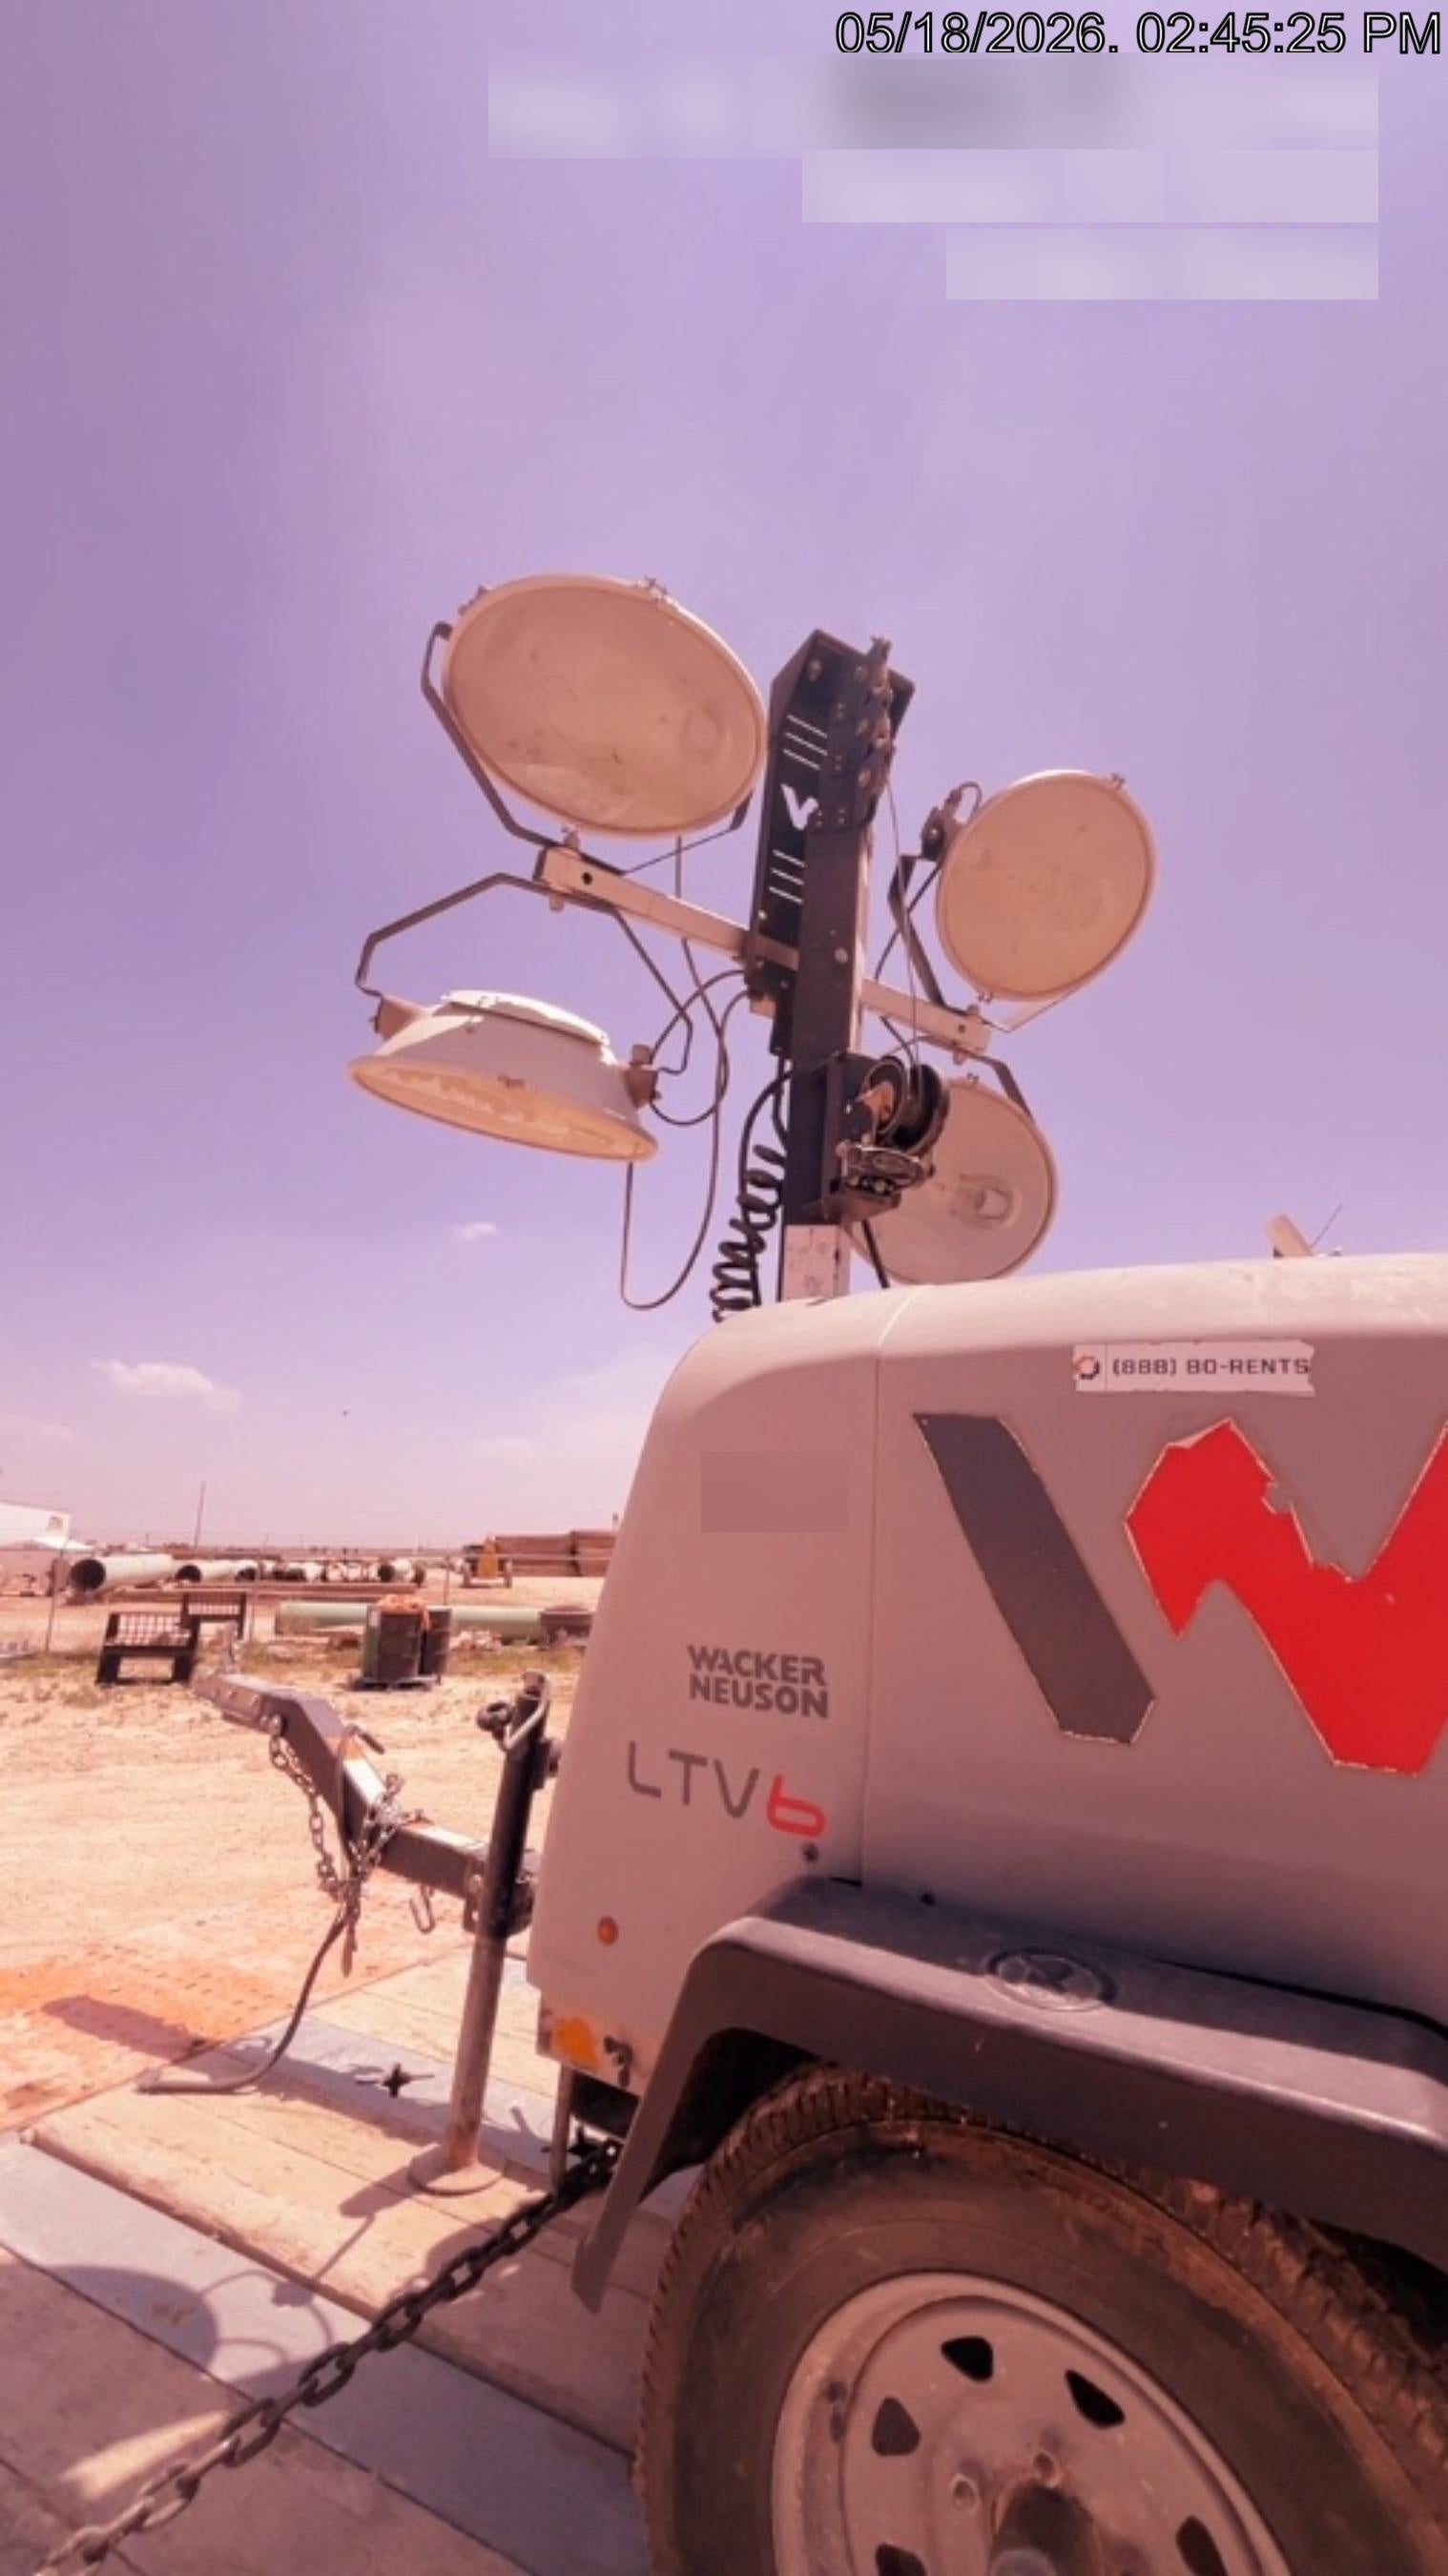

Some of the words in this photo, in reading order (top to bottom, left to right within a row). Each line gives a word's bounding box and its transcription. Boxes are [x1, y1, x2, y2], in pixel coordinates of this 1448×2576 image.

[1112, 1358, 1177, 1376] (888)
[688, 1645, 827, 1688] WACKER
[690, 1672, 829, 1718] NEUSON
[629, 1740, 826, 1839] LTV6
